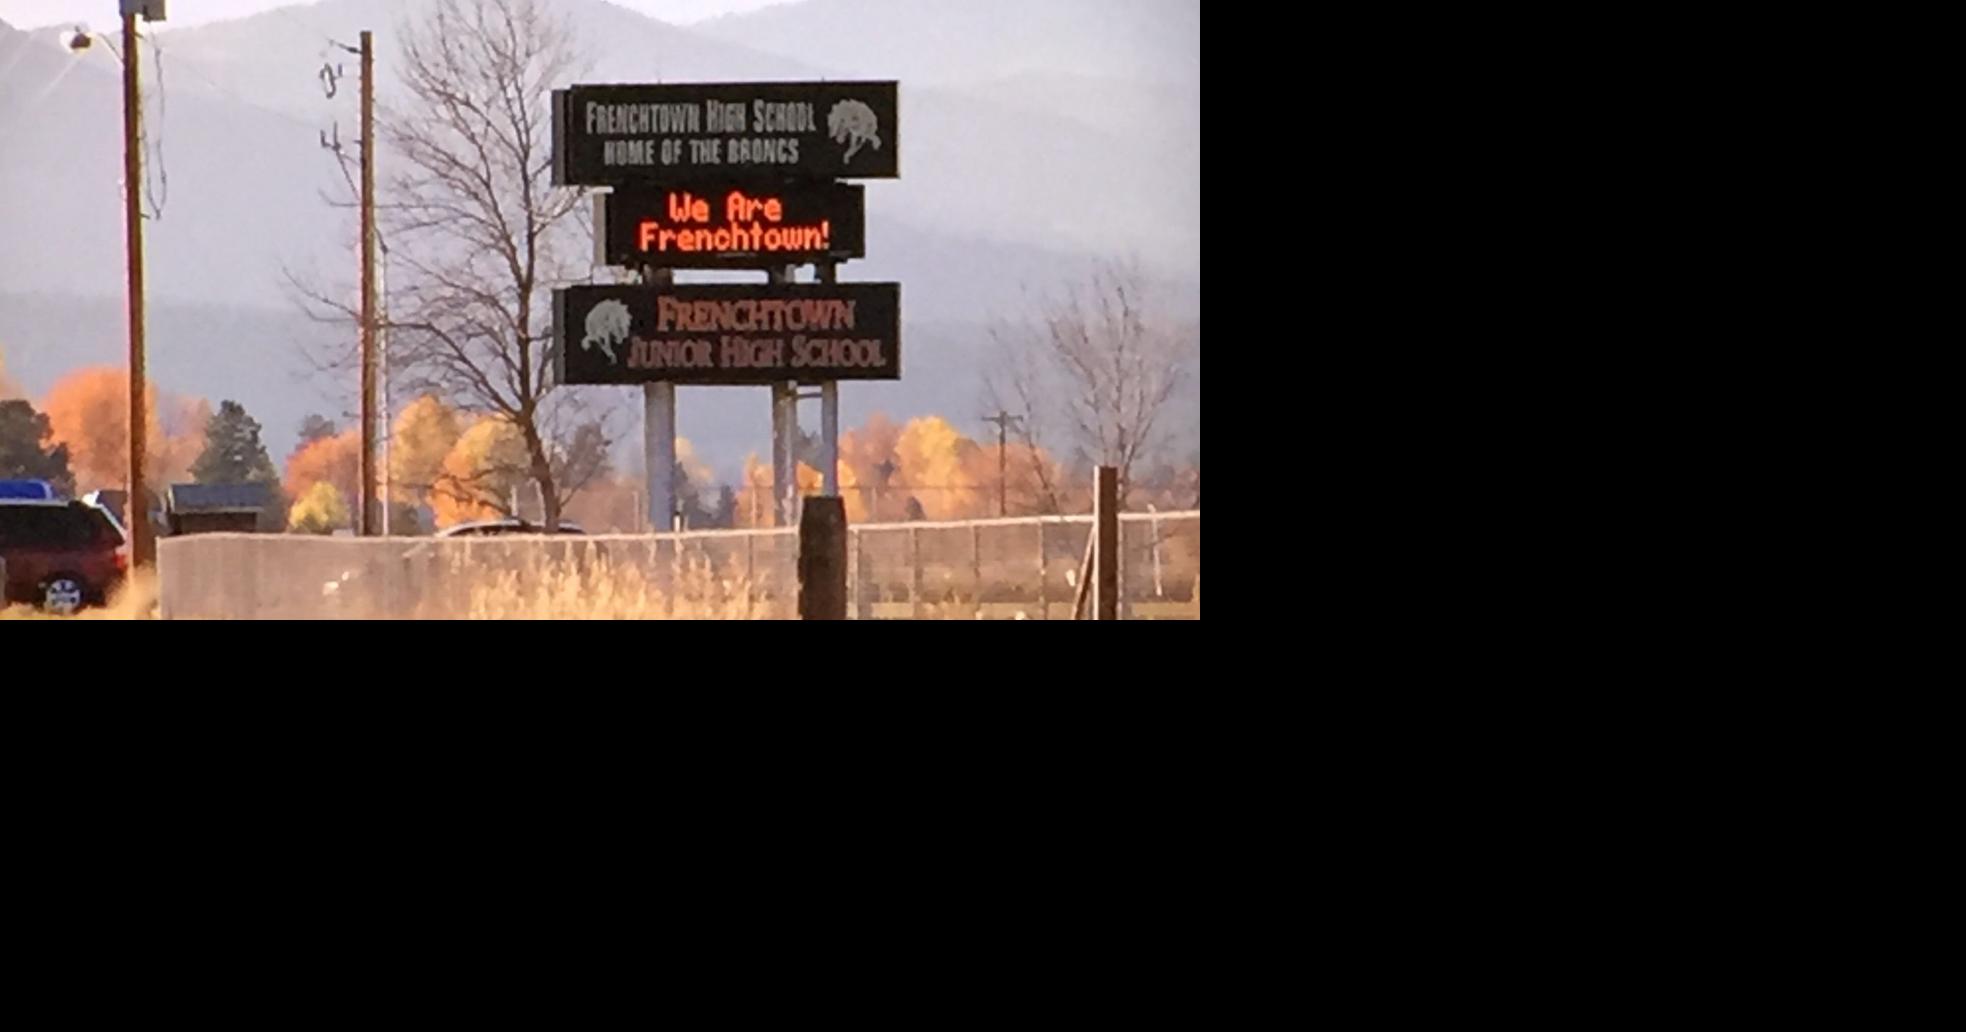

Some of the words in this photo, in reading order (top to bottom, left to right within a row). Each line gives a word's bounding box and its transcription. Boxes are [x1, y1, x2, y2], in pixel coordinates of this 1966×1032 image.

[604, 139, 654, 165] HOME
[661, 139, 681, 165] OF
[689, 139, 721, 164] THE
[728, 138, 799, 165] BRONCS
[669, 192, 709, 222] We
[727, 191, 782, 221] Are
[640, 221, 829, 251] Frenchtown!
